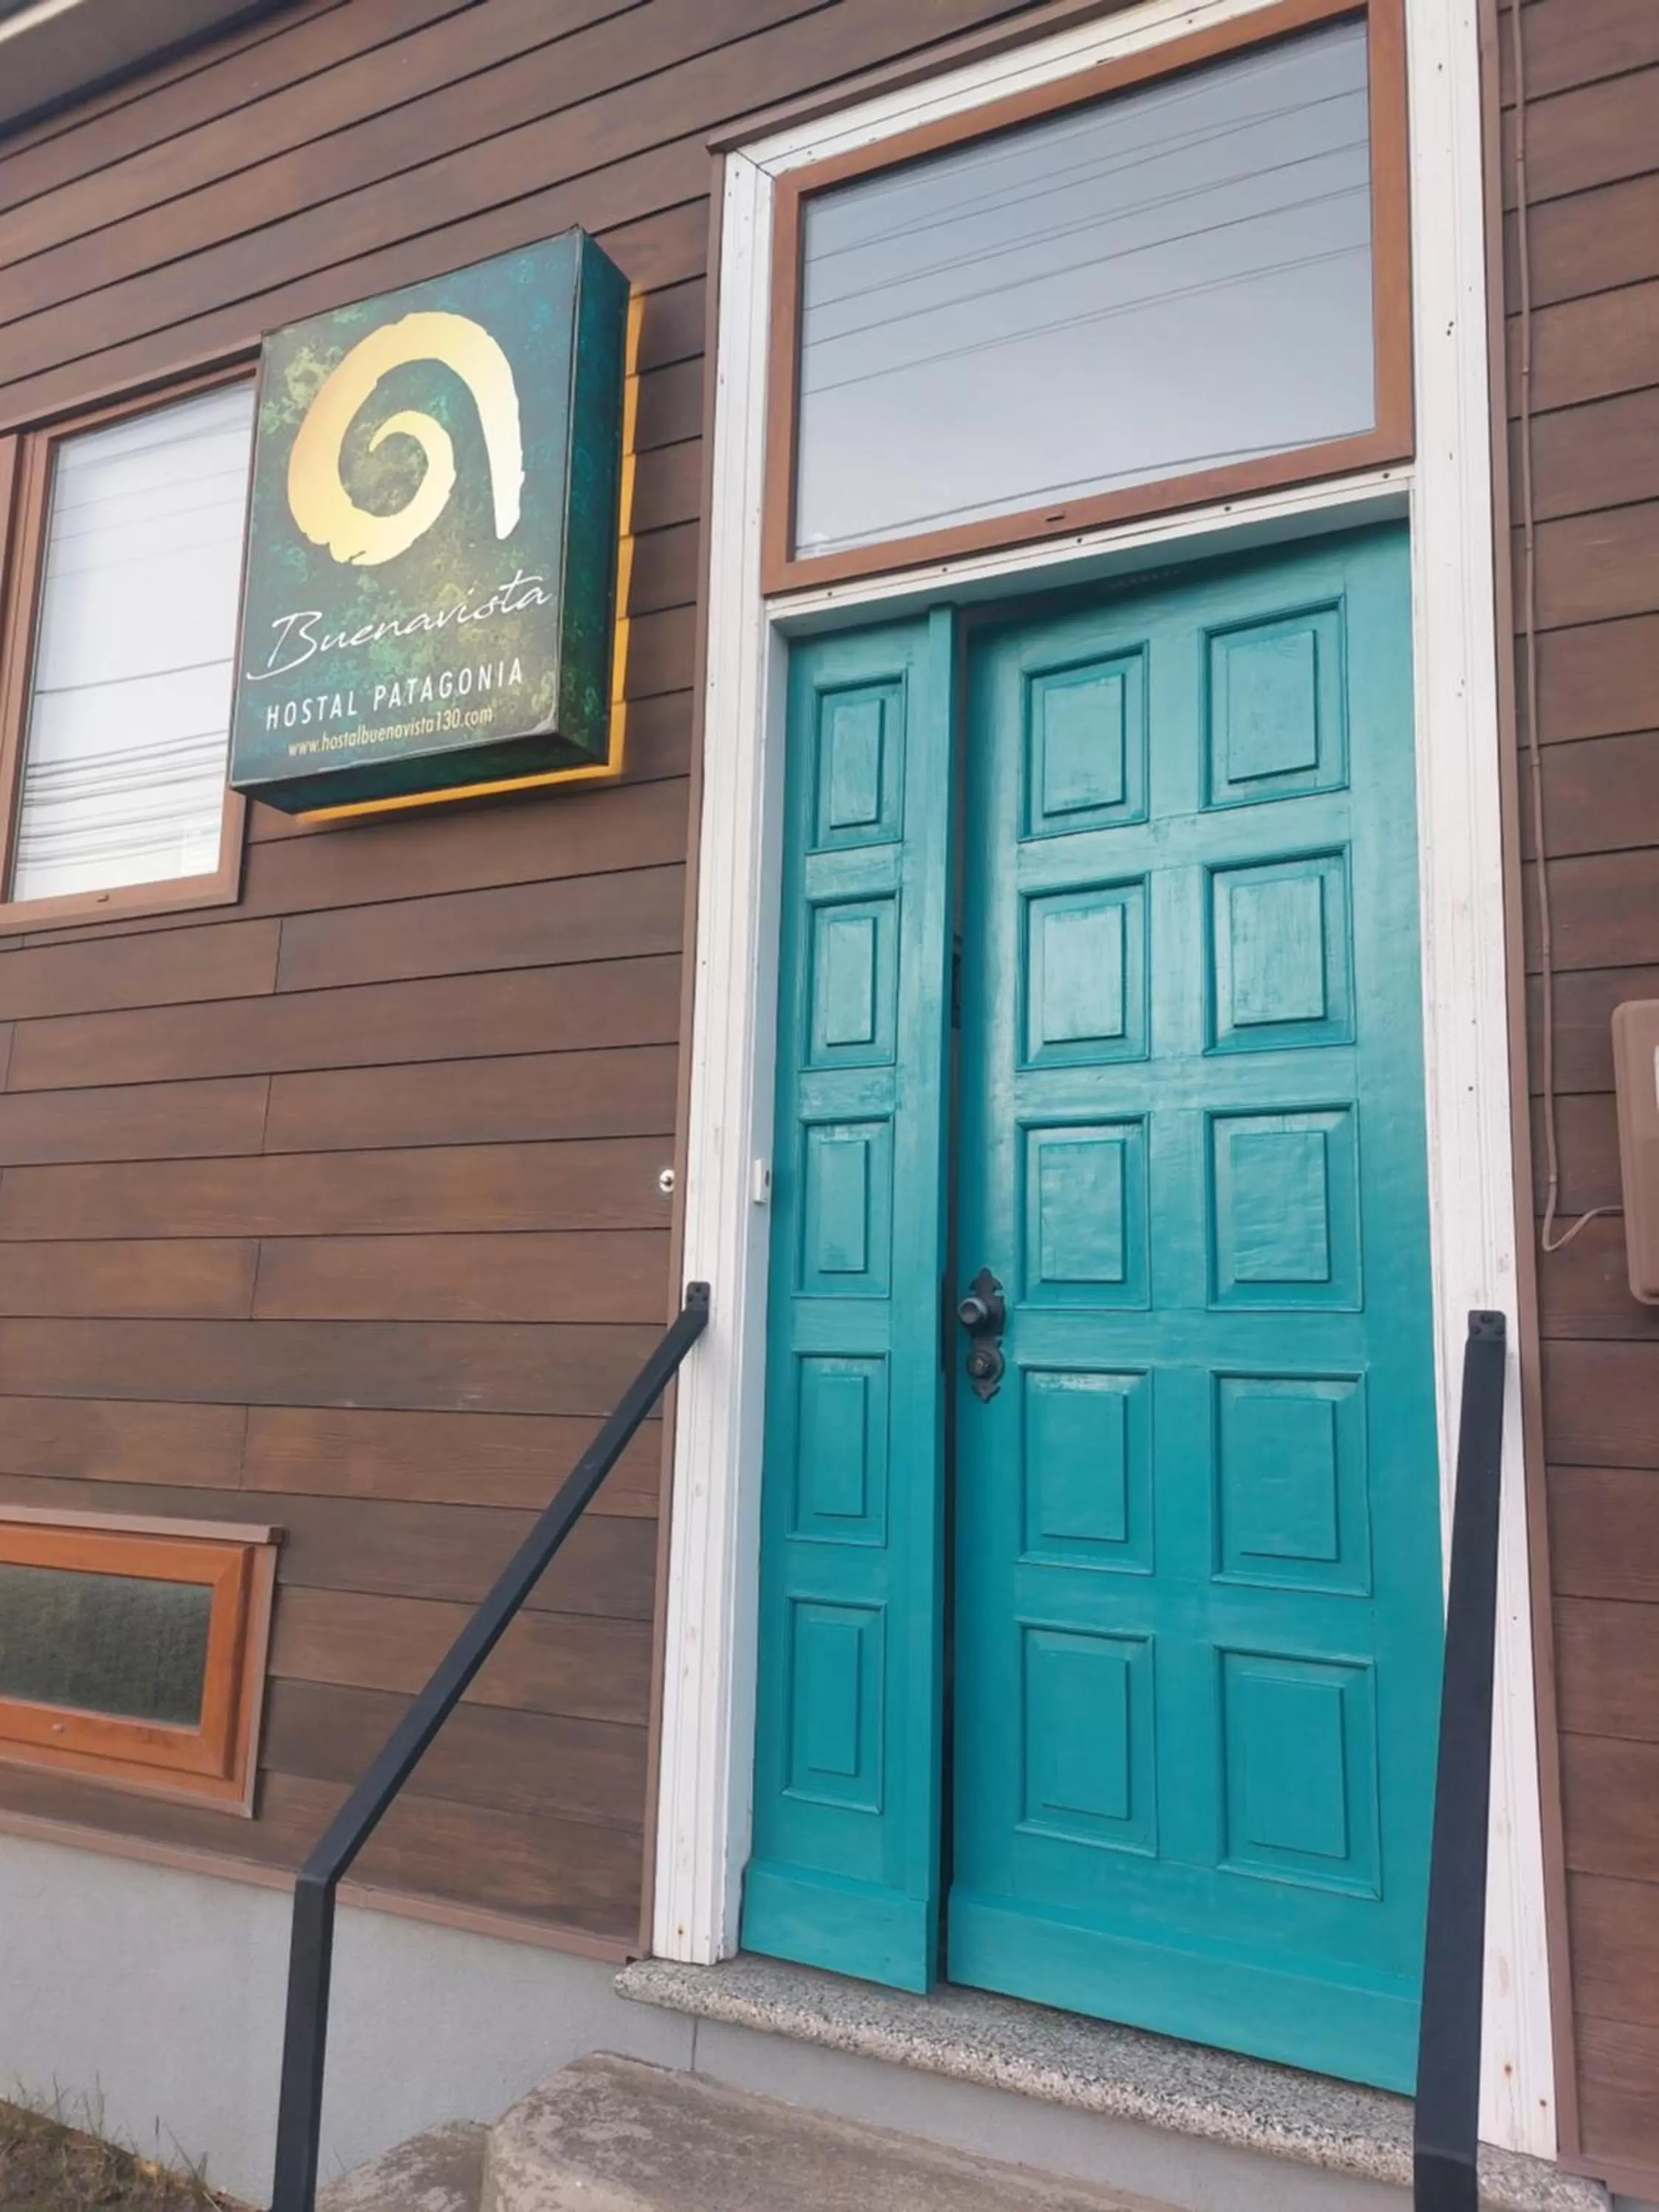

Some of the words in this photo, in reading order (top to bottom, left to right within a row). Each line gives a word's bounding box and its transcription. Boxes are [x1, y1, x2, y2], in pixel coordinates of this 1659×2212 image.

[246, 568, 552, 681] Buenavista
[265, 692, 358, 731] HOSTAL
[372, 657, 524, 713] PATAGONIA
[288, 706, 494, 757] www.hostalbuenavista130.com
